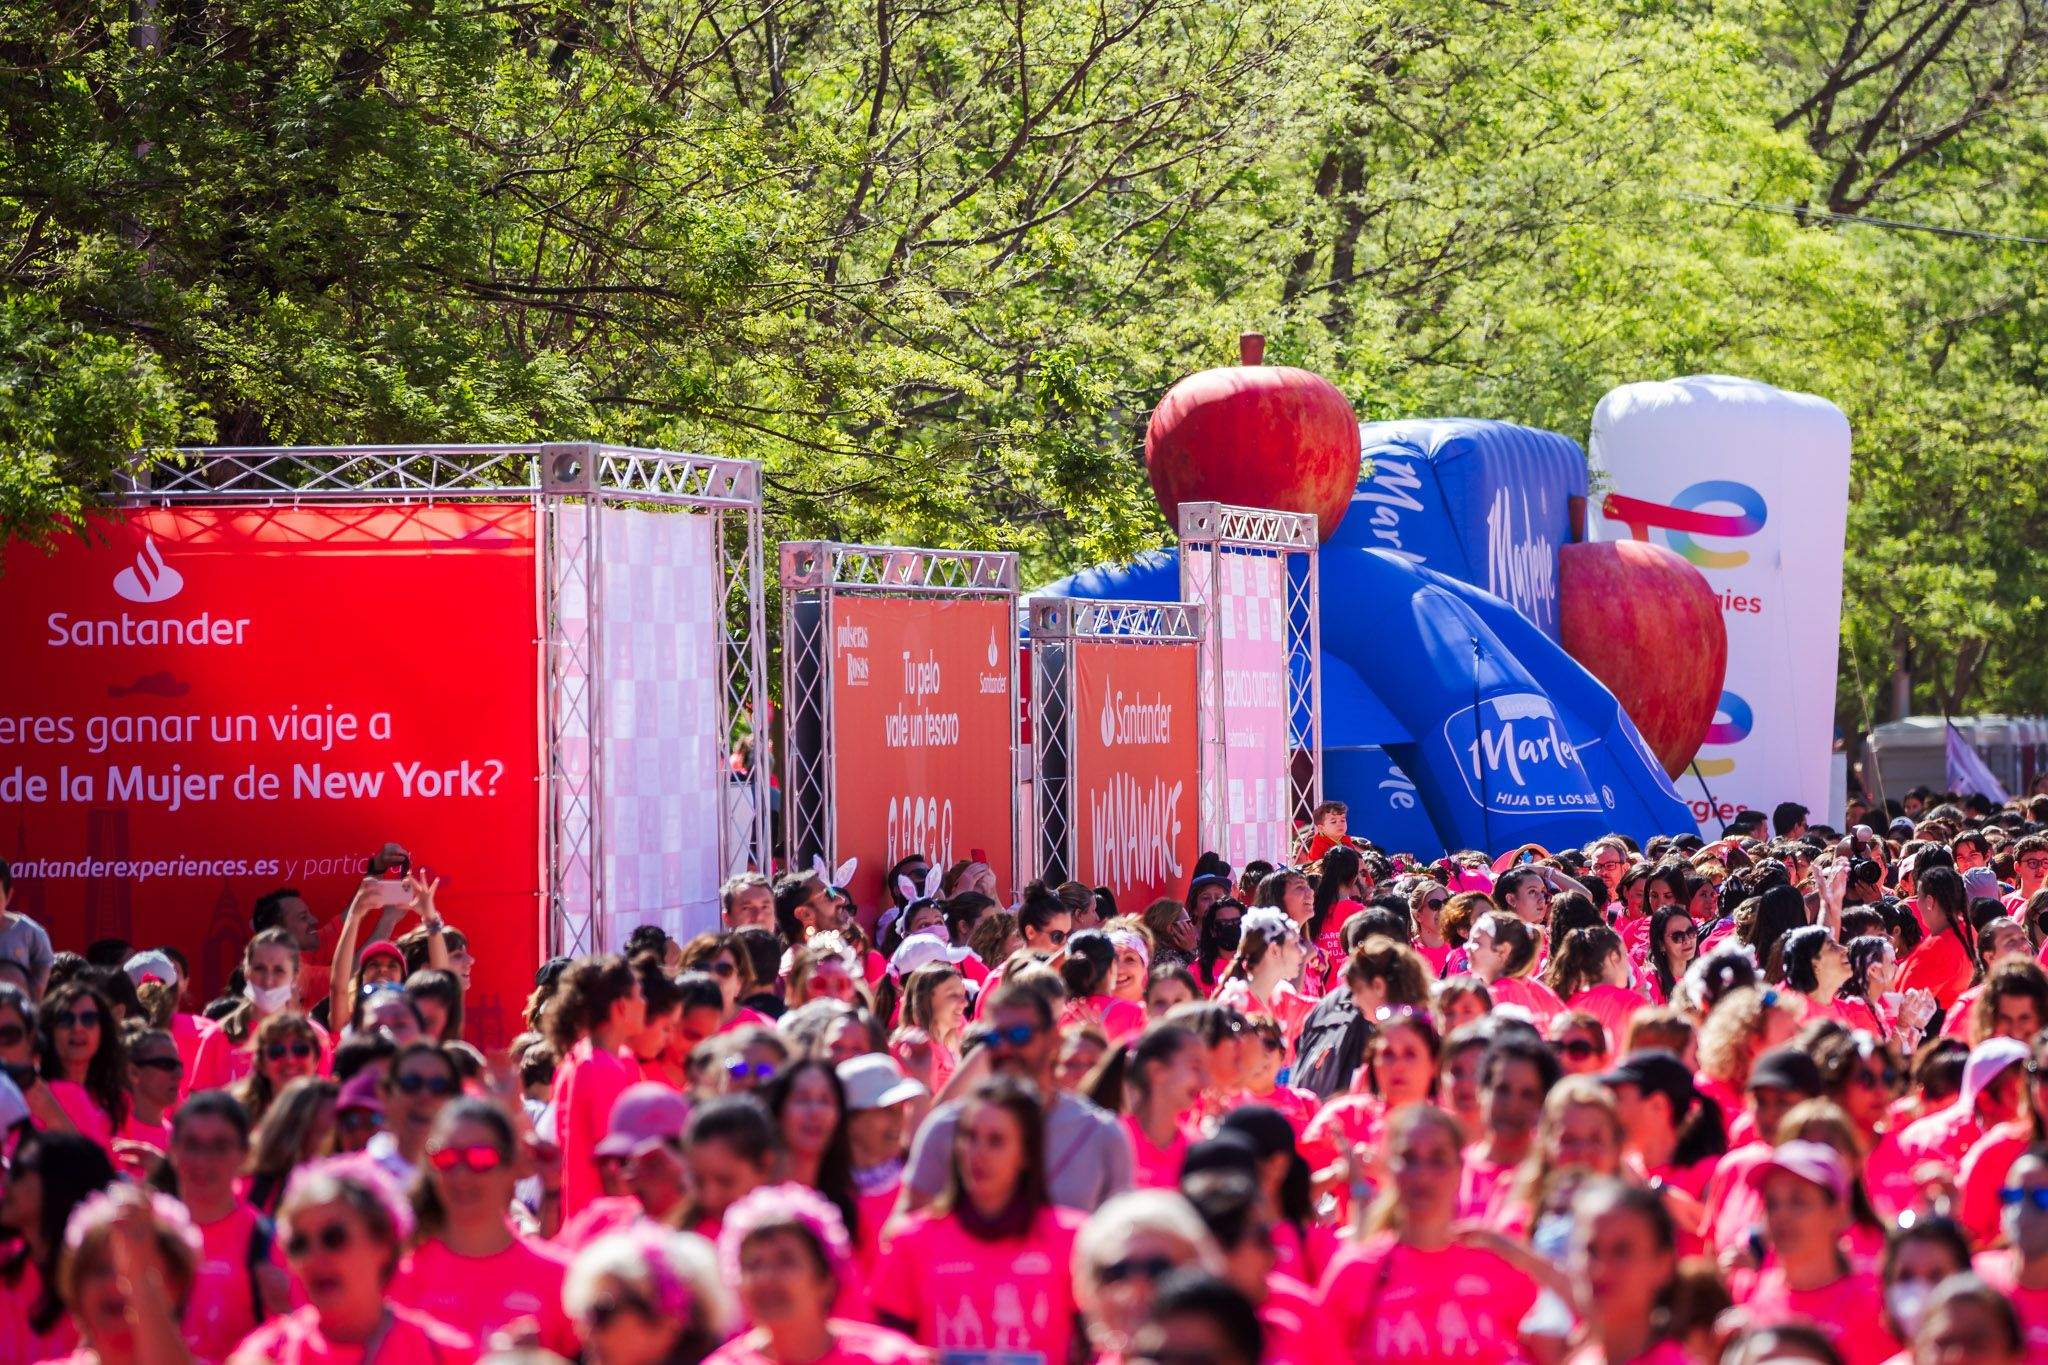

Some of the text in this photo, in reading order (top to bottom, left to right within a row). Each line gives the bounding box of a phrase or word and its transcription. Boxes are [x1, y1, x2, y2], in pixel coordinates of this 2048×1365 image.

[47, 611, 251, 647] Santander
[837, 615, 869, 658] pulseras
[902, 649, 940, 706] Tu pelo
[979, 672, 1007, 694] Santander
[0, 704, 392, 754] eres ganar un viaje a
[885, 702, 959, 747] vale un tesoro
[1117, 690, 1172, 745] Santander
[0, 758, 506, 812] de la Mujer de New York?
[1496, 791, 1531, 807] HIJA
[1535, 794, 1556, 806] DE
[1558, 794, 1584, 806] LOS
[1090, 771, 1183, 896] WANAWAKE
[7, 855, 280, 883] antanderexperiences.es
[284, 859, 298, 881] y
